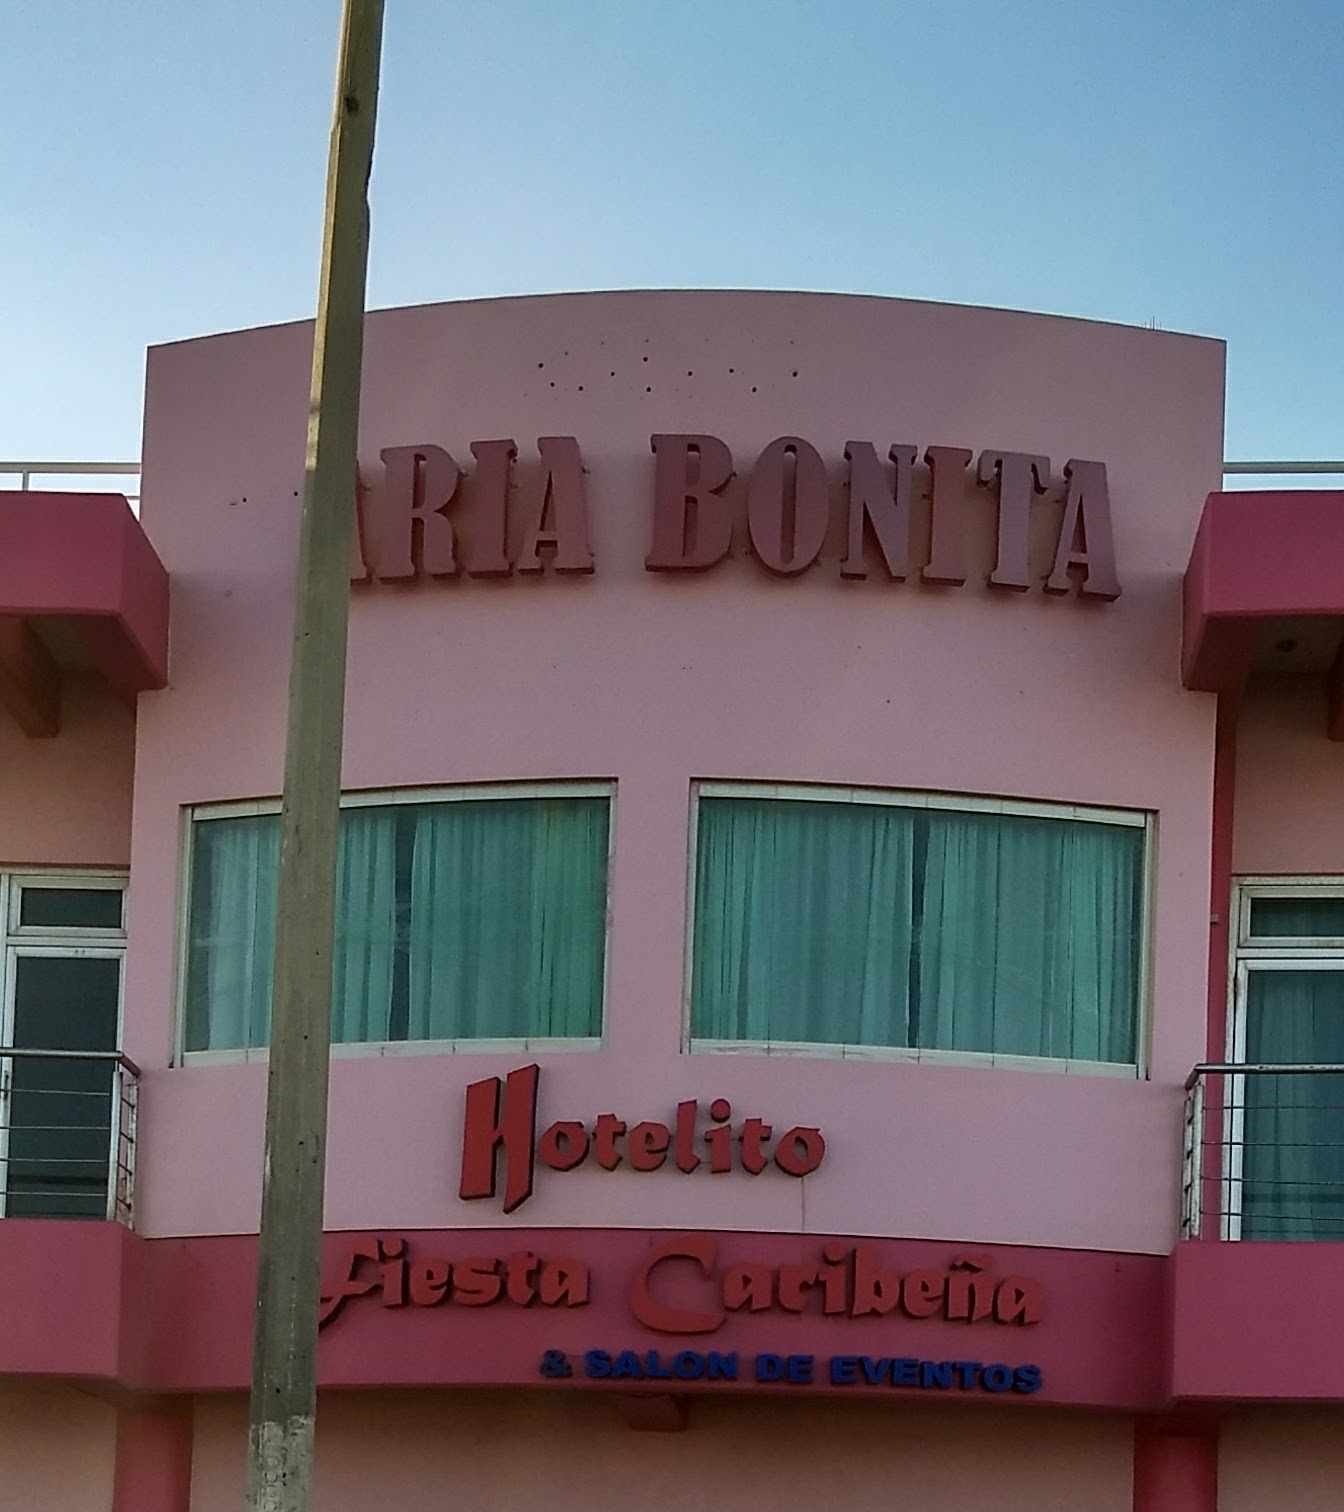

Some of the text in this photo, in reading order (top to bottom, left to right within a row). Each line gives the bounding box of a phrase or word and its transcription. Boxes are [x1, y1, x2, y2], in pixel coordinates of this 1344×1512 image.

[348, 433, 1124, 601] RIA BONITA
[459, 1063, 827, 1214] Hotelito
[318, 1233, 1046, 1335] Fiesta Caribeña
[541, 1349, 1043, 1394] & SALON DE EVENTOS
